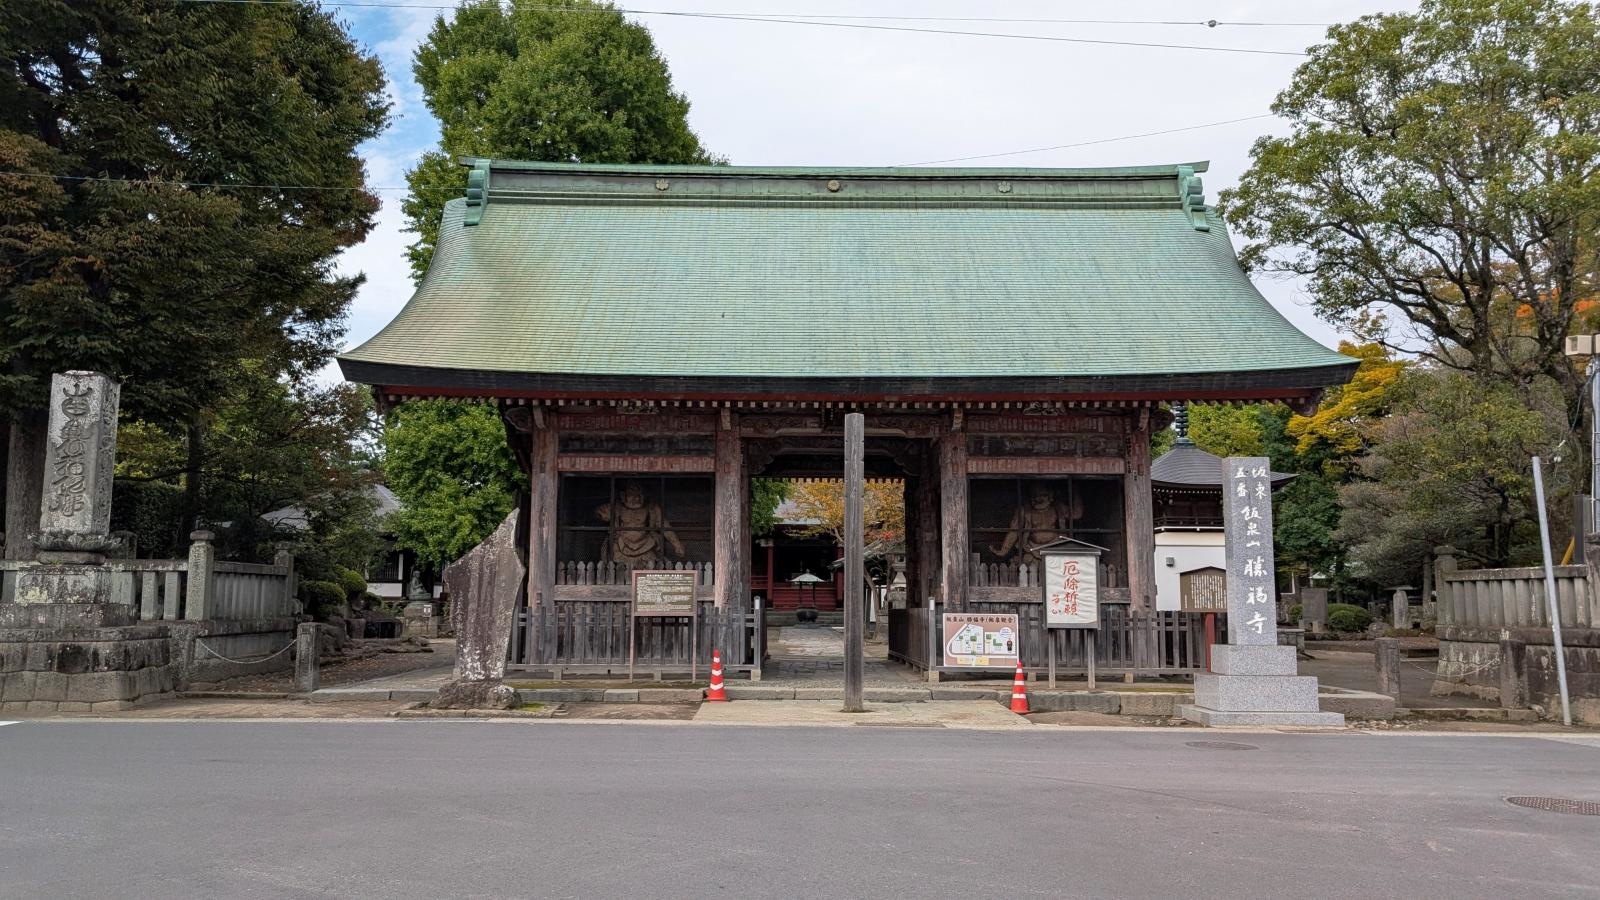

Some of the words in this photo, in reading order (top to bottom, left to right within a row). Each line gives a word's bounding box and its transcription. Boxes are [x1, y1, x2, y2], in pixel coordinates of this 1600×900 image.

[1235, 467, 1249, 497] 五番
[1251, 467, 1268, 499] 坂東
[1062, 560, 1080, 616] 厄除祈願
